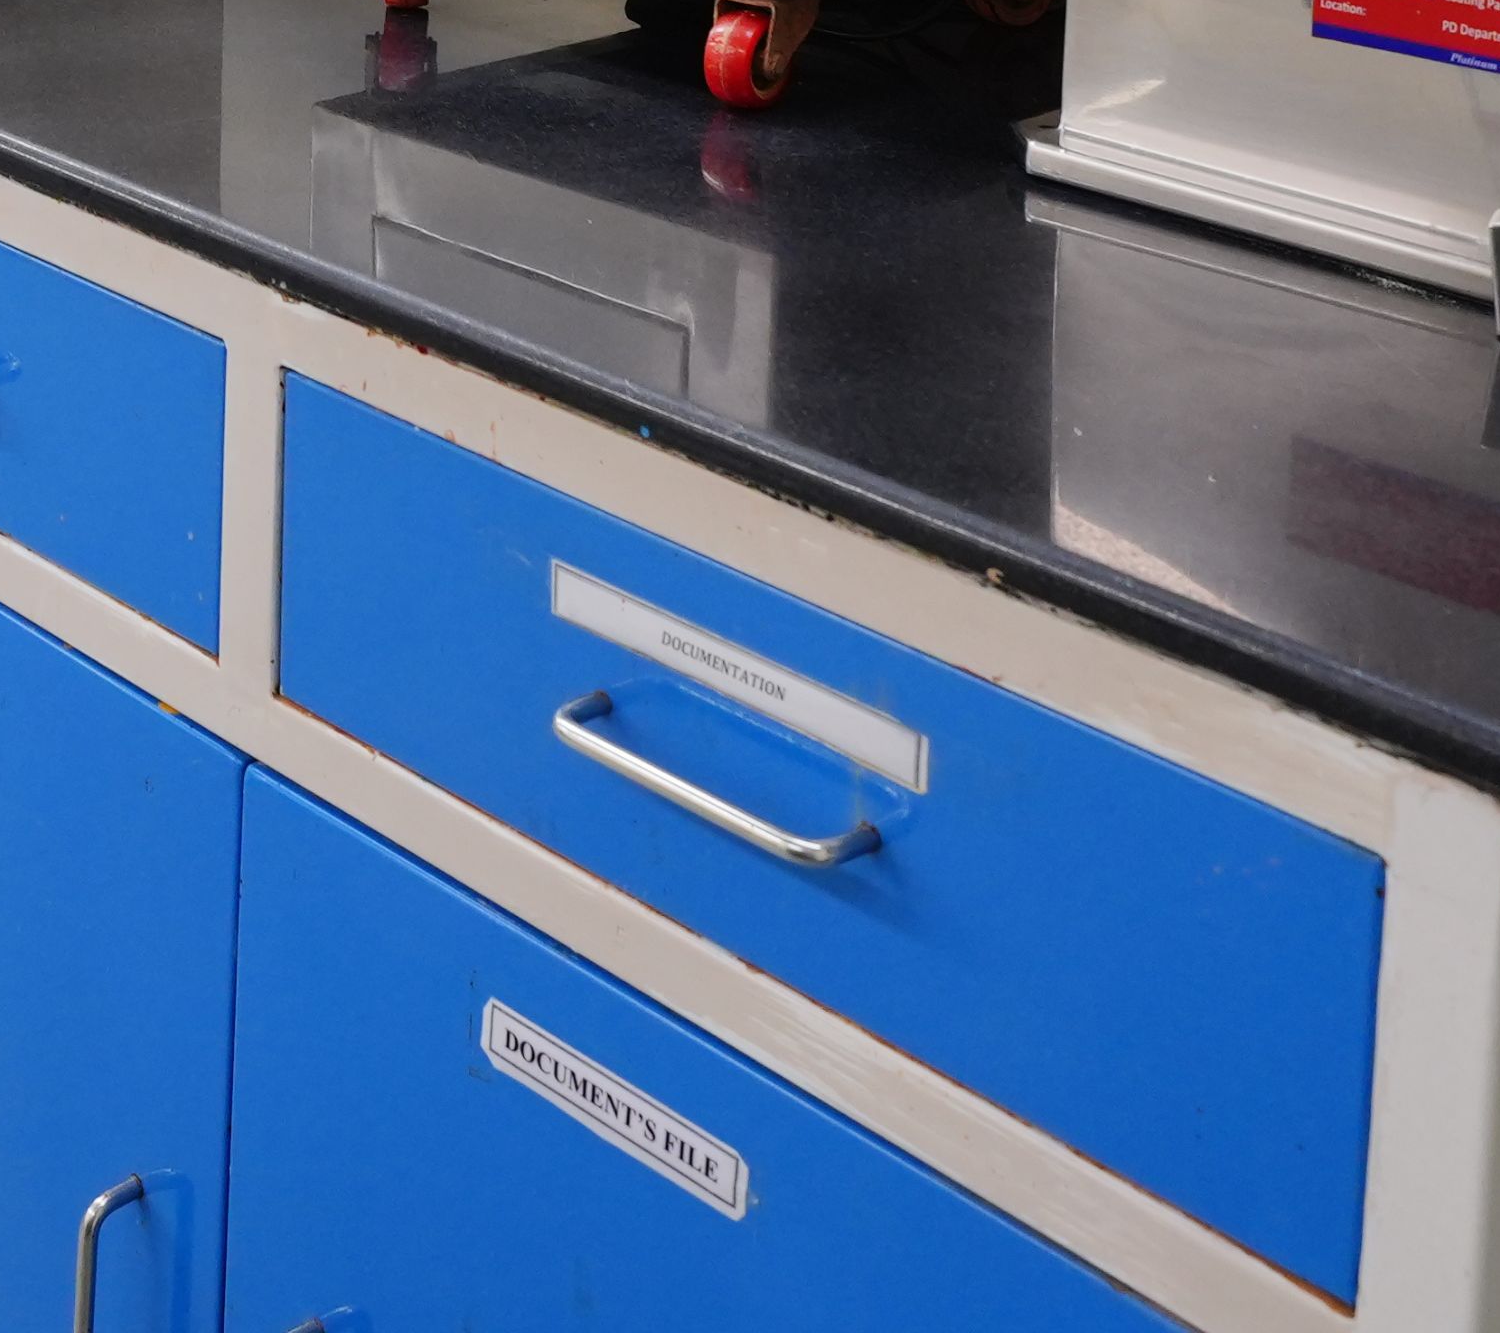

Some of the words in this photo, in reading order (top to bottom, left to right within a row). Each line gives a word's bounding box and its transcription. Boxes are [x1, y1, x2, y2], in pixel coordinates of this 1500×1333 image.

[1441, 20, 1458, 33] PD
[1450, 52, 1498, 71] Platinum
[661, 631, 786, 701] DOCUMENTATION
[504, 1028, 657, 1143] DOCUMENT'S
[663, 1128, 719, 1183] FILE
